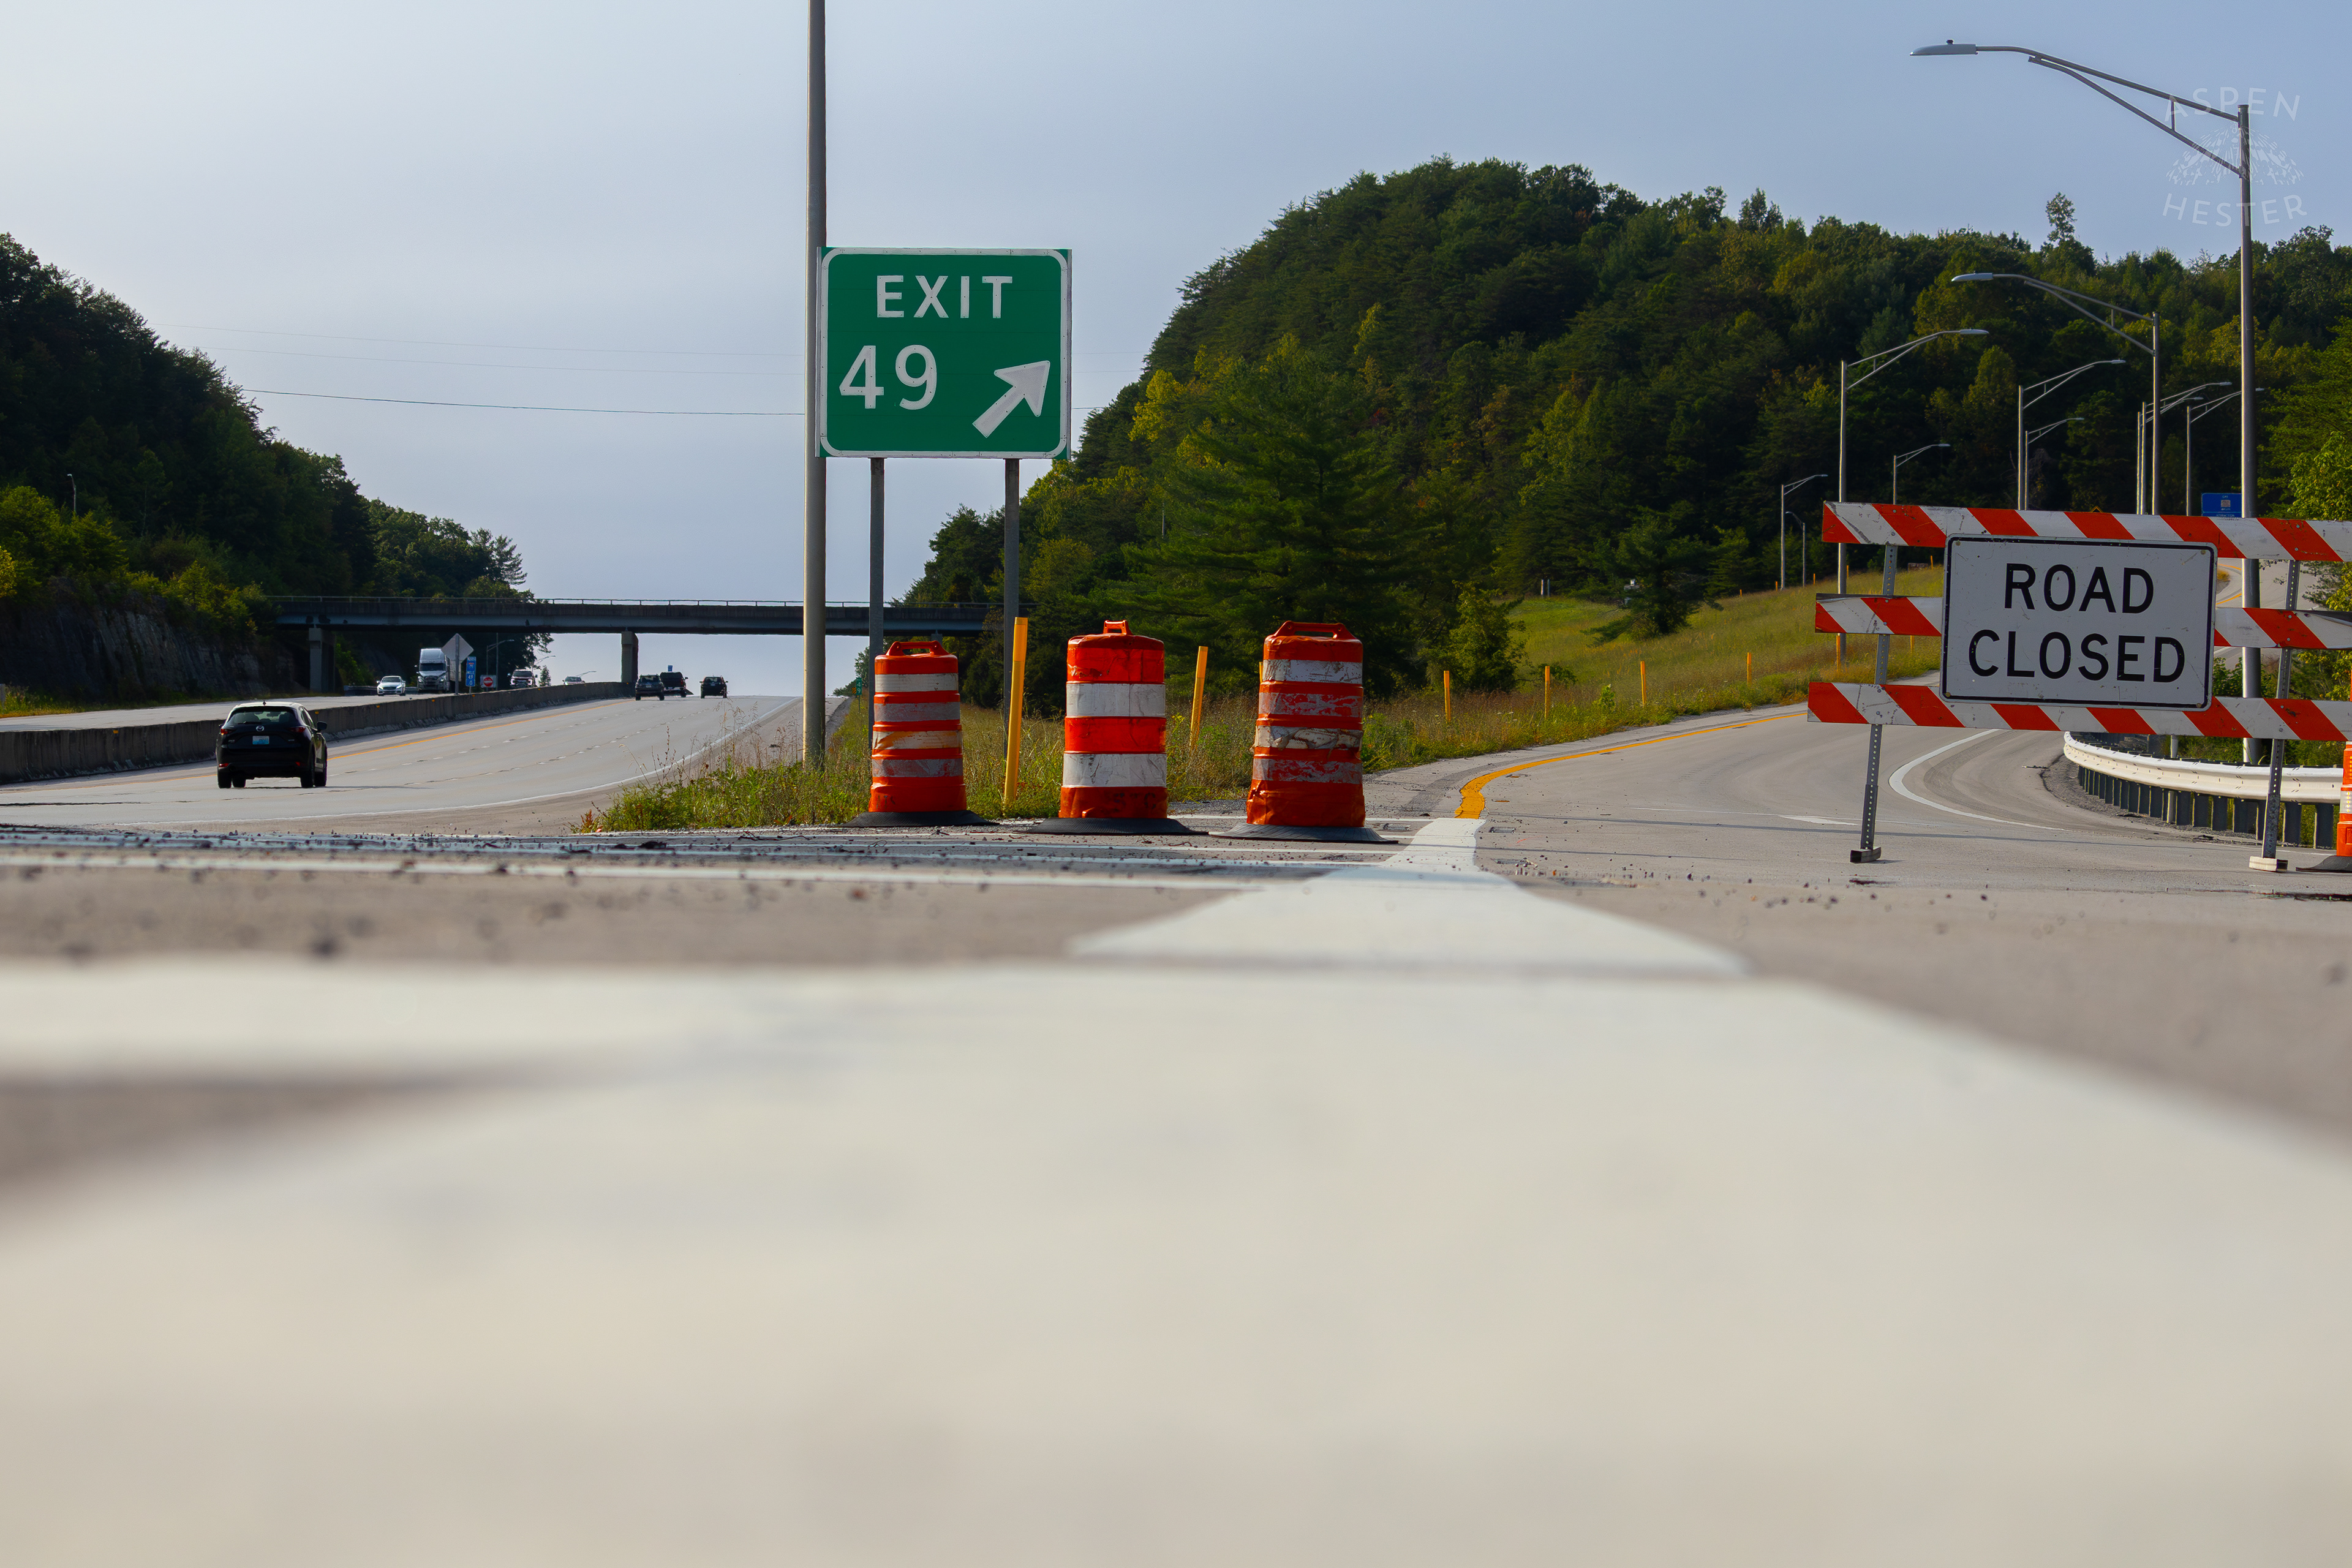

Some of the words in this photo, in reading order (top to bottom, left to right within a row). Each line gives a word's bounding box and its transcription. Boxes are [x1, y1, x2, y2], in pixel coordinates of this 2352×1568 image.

[876, 276, 1013, 318] EXIT
[839, 344, 937, 410] 49
[2005, 563, 2154, 614] ROAD
[1969, 629, 2185, 683] CLOSED
